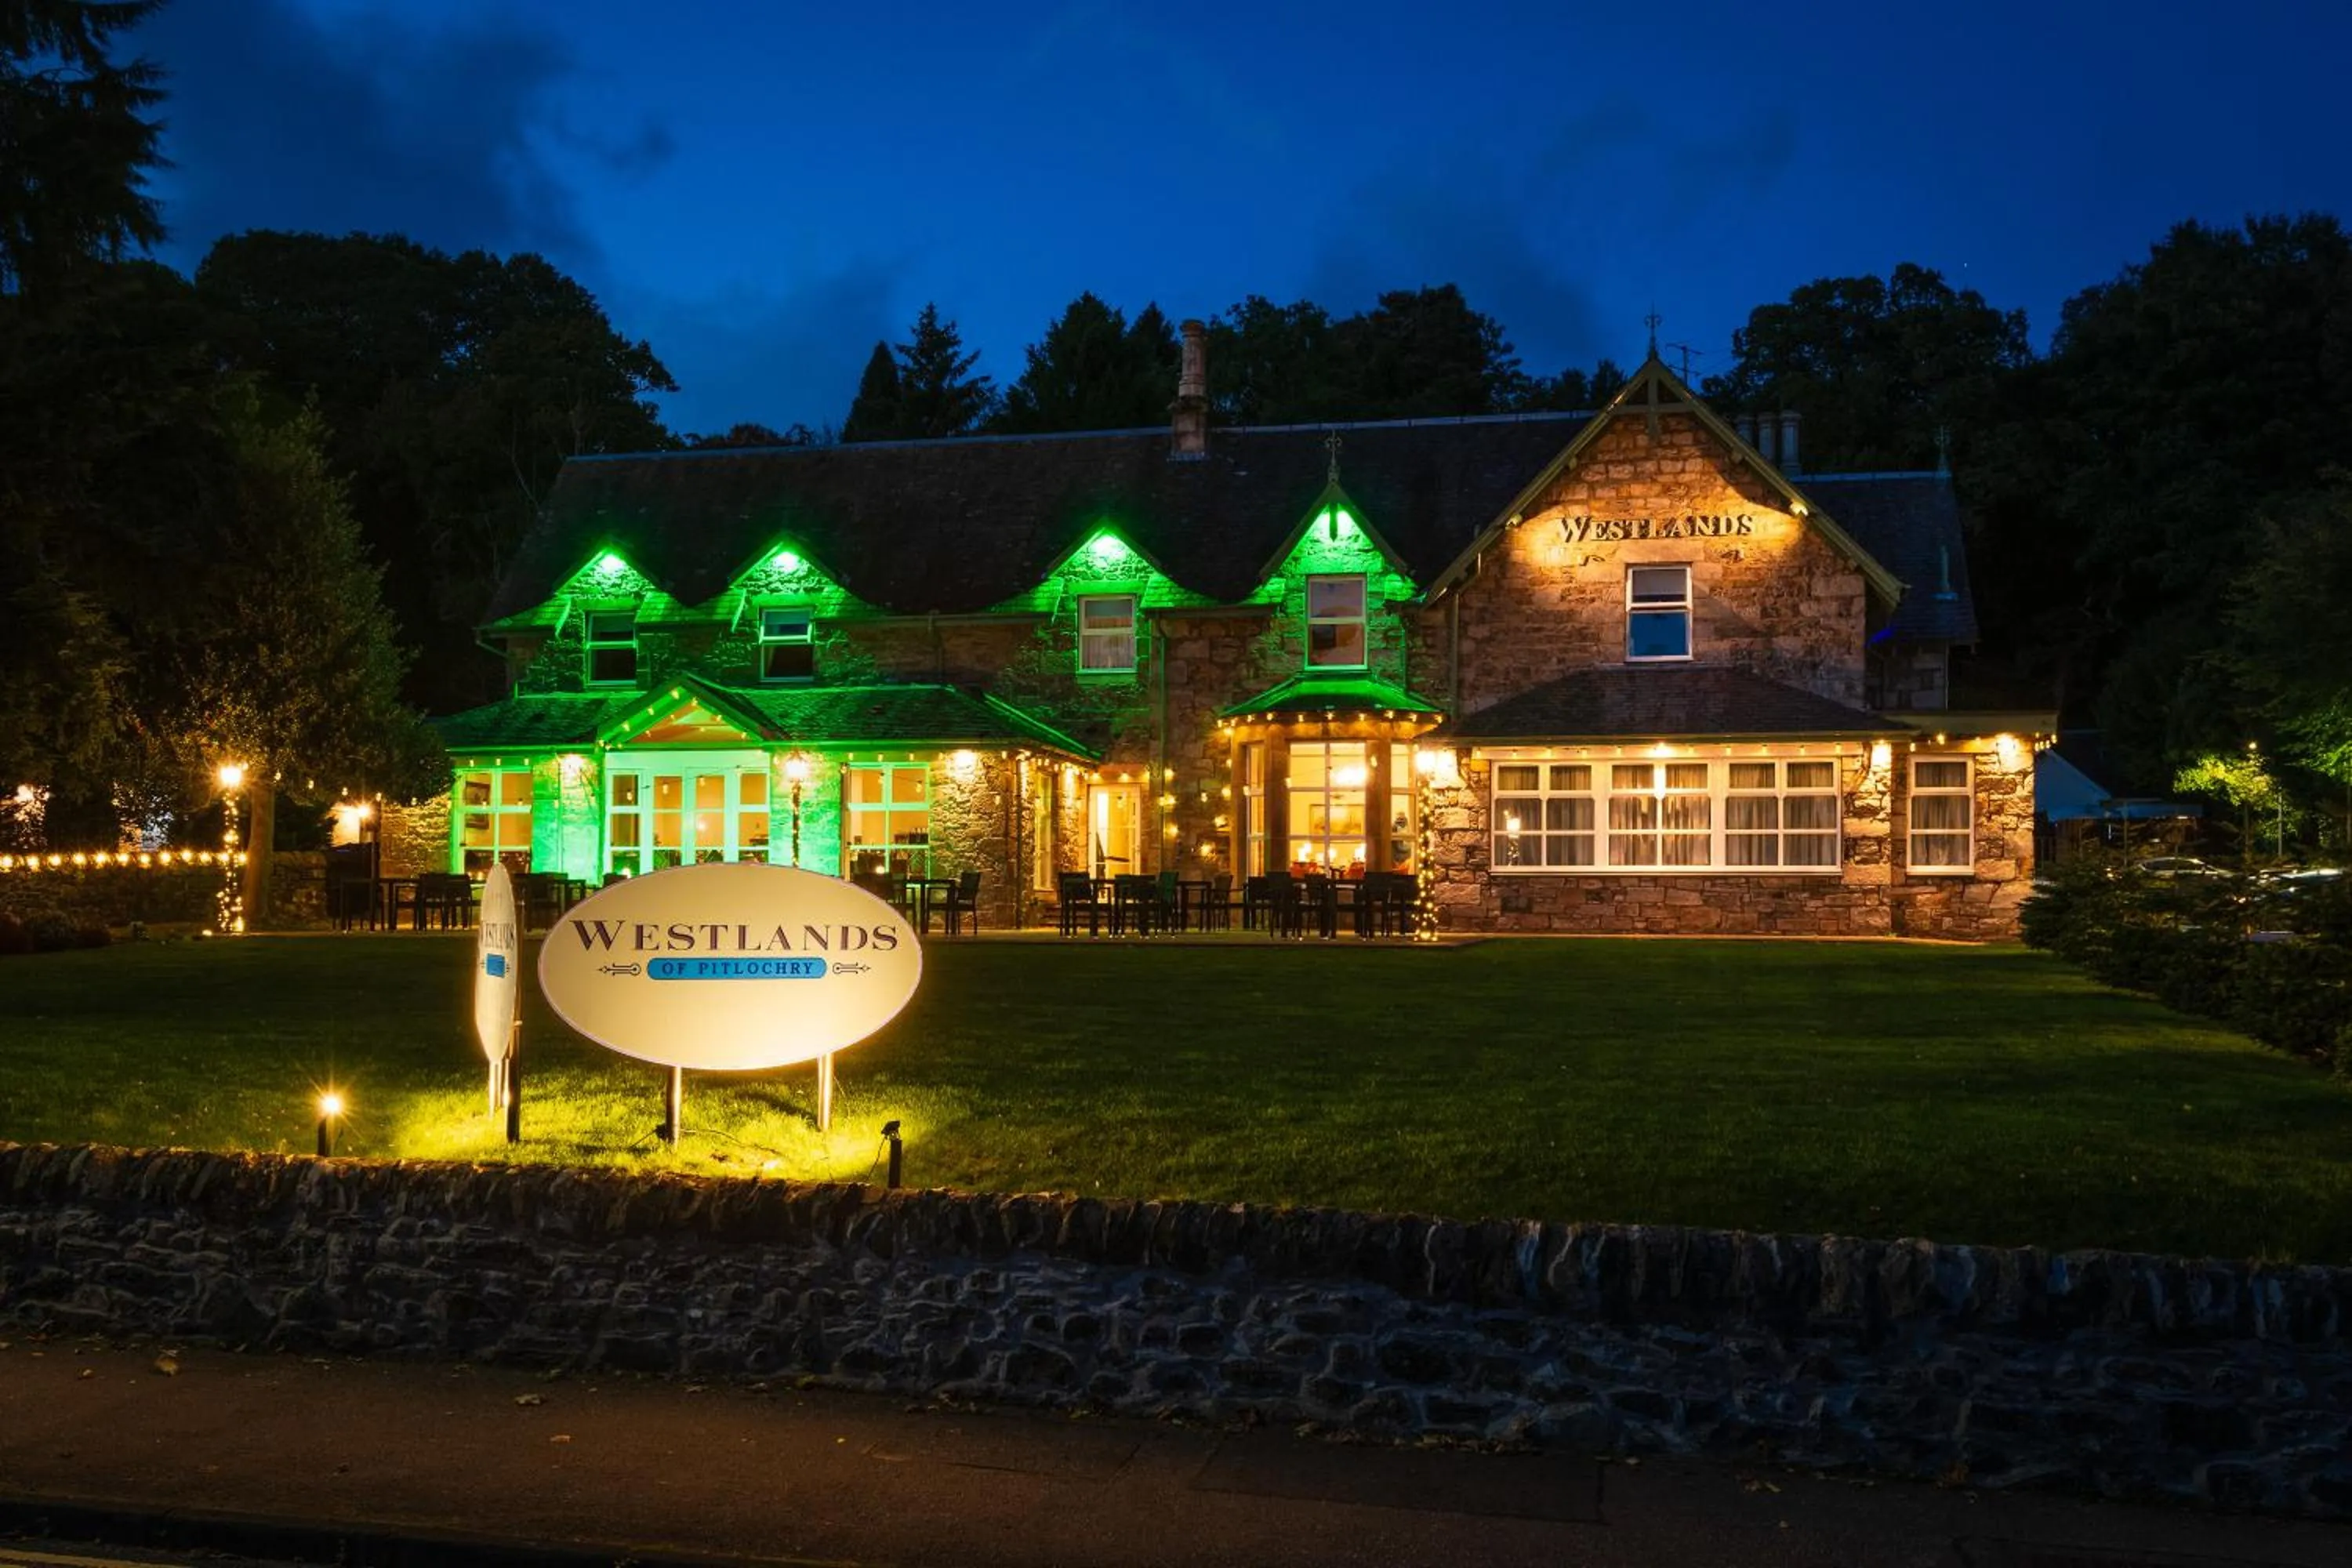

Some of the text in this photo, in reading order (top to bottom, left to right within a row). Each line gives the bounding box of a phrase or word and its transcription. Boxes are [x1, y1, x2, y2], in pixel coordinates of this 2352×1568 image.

[1555, 514, 1754, 543] WESTLANDS
[569, 920, 898, 952] WESTLANDS
[662, 962, 814, 975] OF PITLOCHRY
